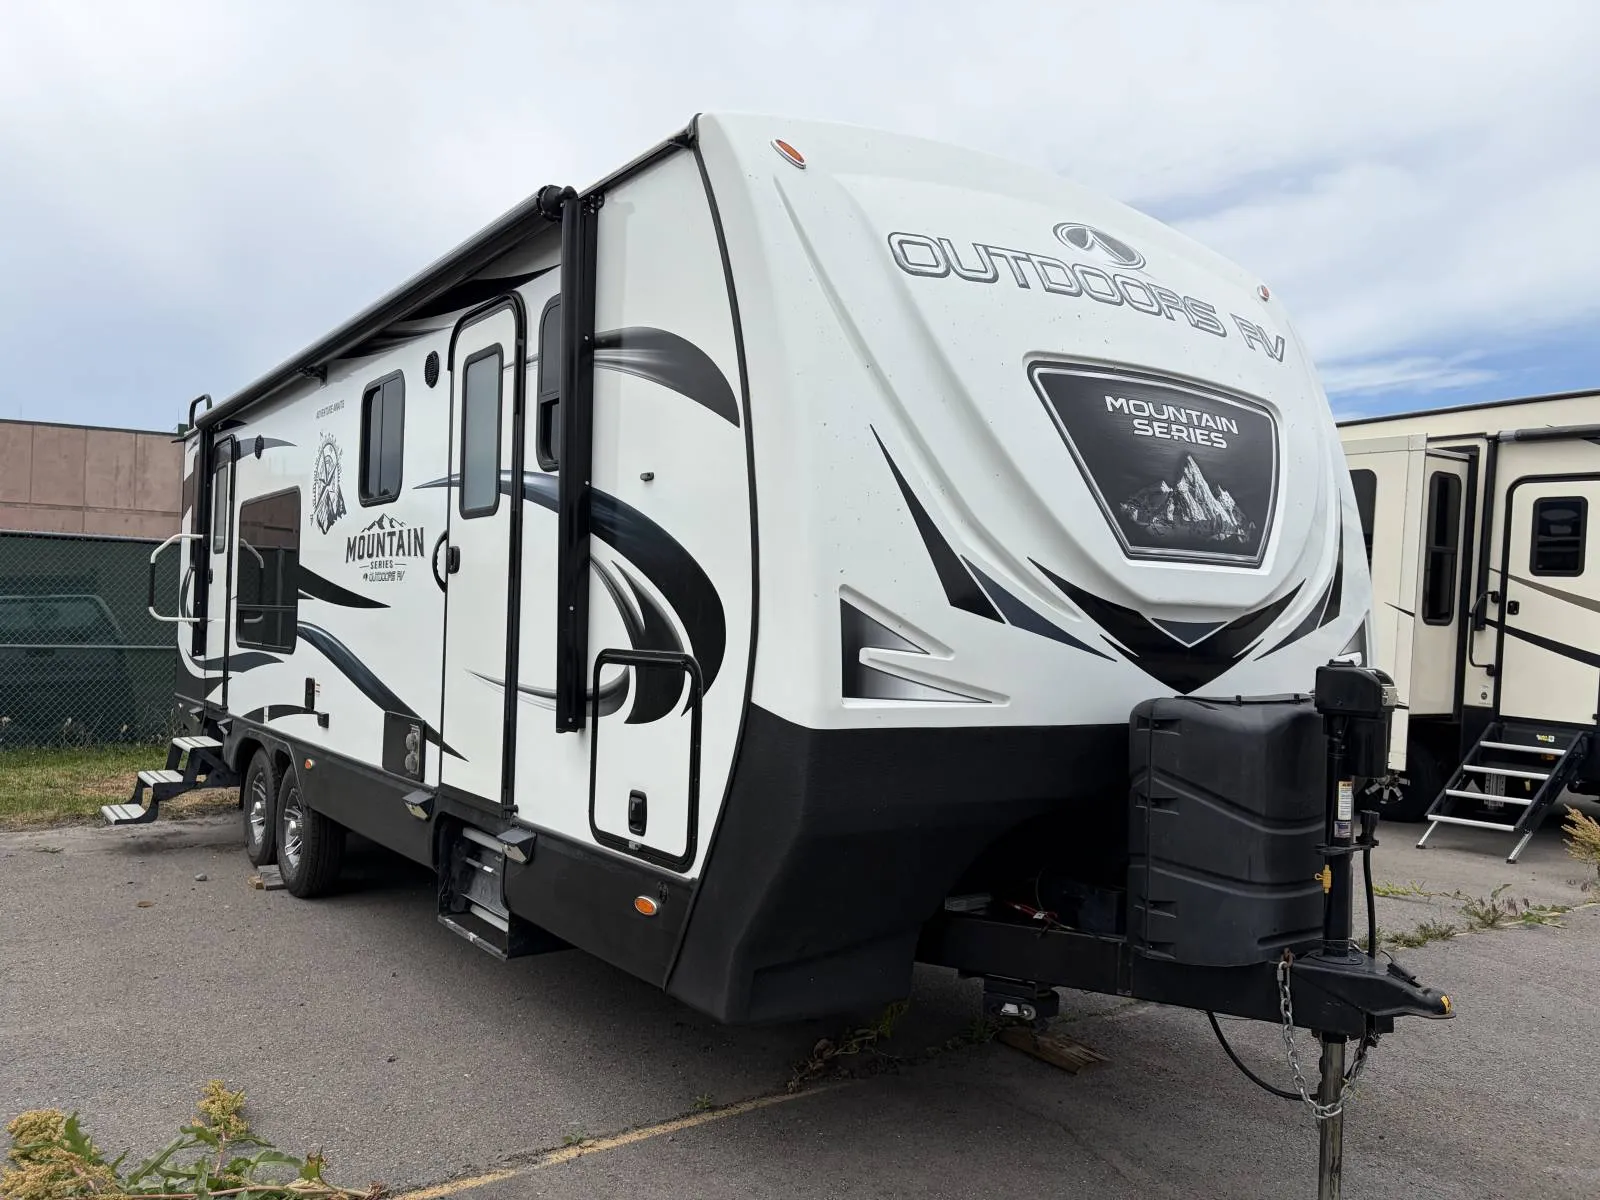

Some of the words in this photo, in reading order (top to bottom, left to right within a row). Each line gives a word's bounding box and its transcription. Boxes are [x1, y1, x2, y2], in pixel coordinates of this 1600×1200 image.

[887, 231, 1227, 338] OUTDOORS
[1231, 313, 1285, 362] RV
[1104, 395, 1239, 435] MOUNTAIN
[1132, 418, 1228, 449] SERIES
[345, 526, 425, 563] MOUNTAIN
[368, 571, 396, 582] OUTDOORS
[396, 570, 406, 581] RV
[370, 560, 394, 570] SERIES
